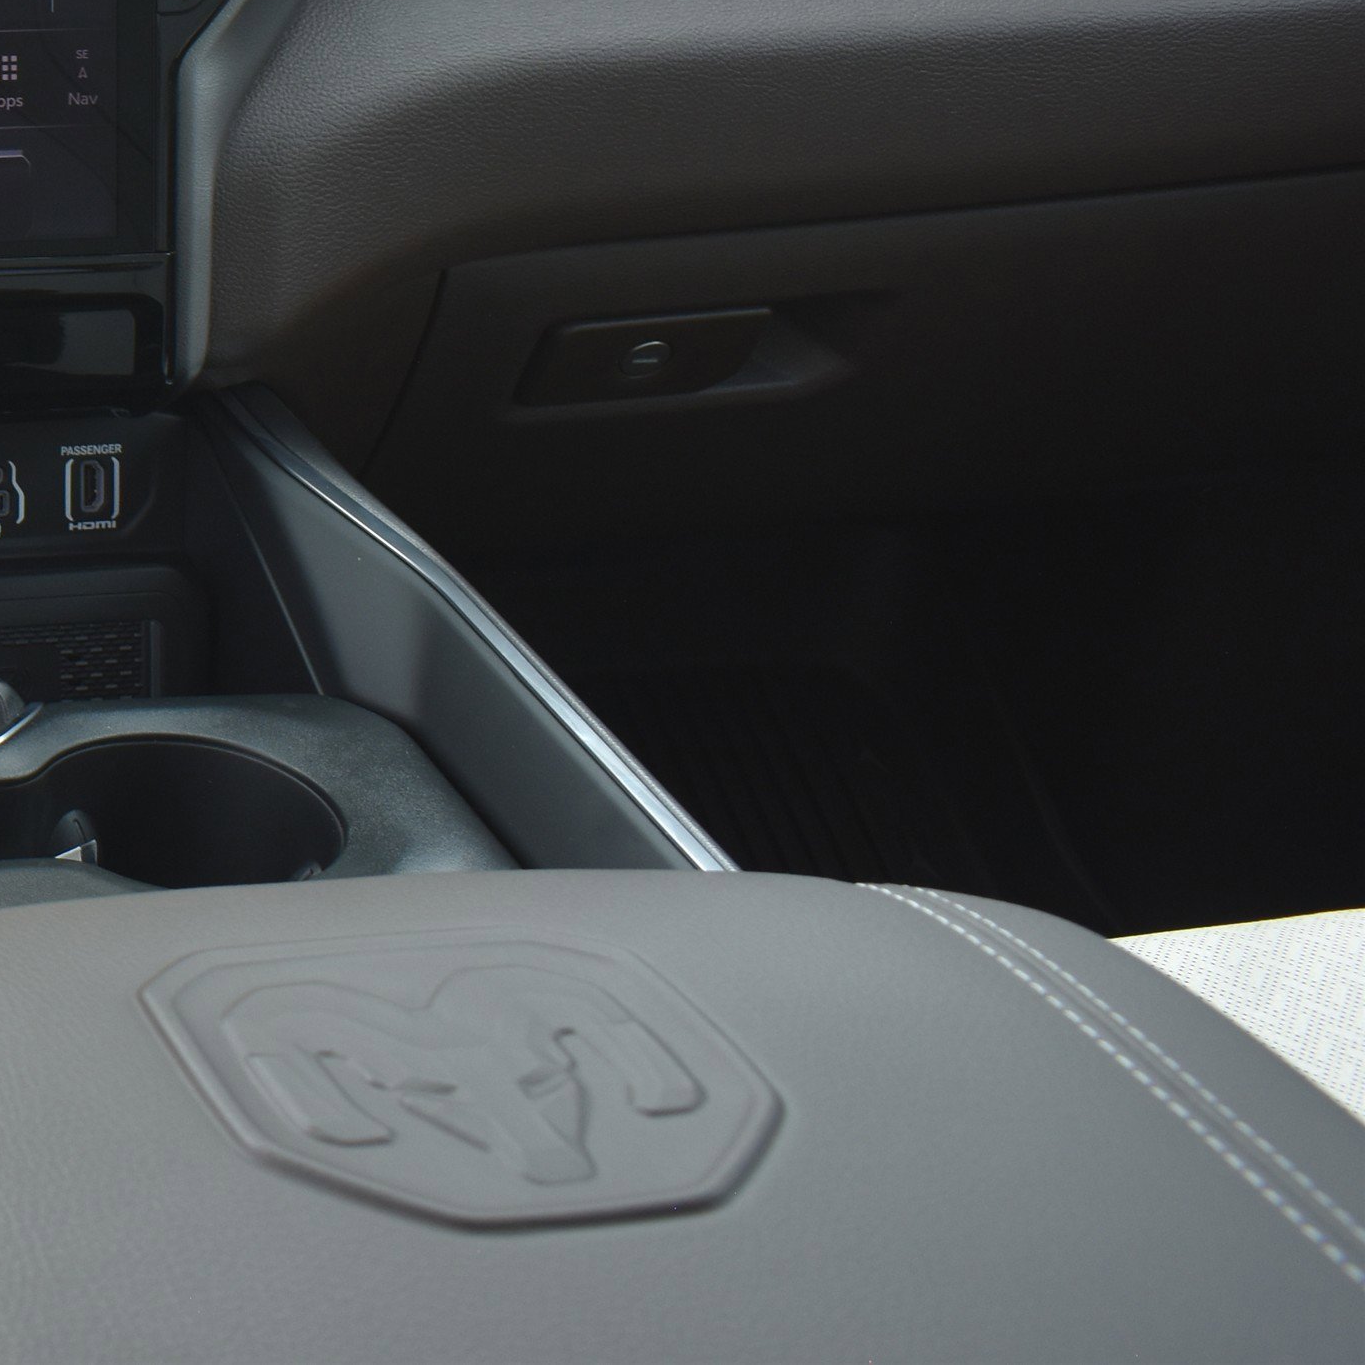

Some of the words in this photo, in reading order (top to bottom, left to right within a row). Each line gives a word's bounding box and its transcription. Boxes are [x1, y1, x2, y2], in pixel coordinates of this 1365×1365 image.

[76, 50, 89, 60] SE
[68, 92, 98, 106] Nav
[60, 443, 122, 456] PASSENGER
